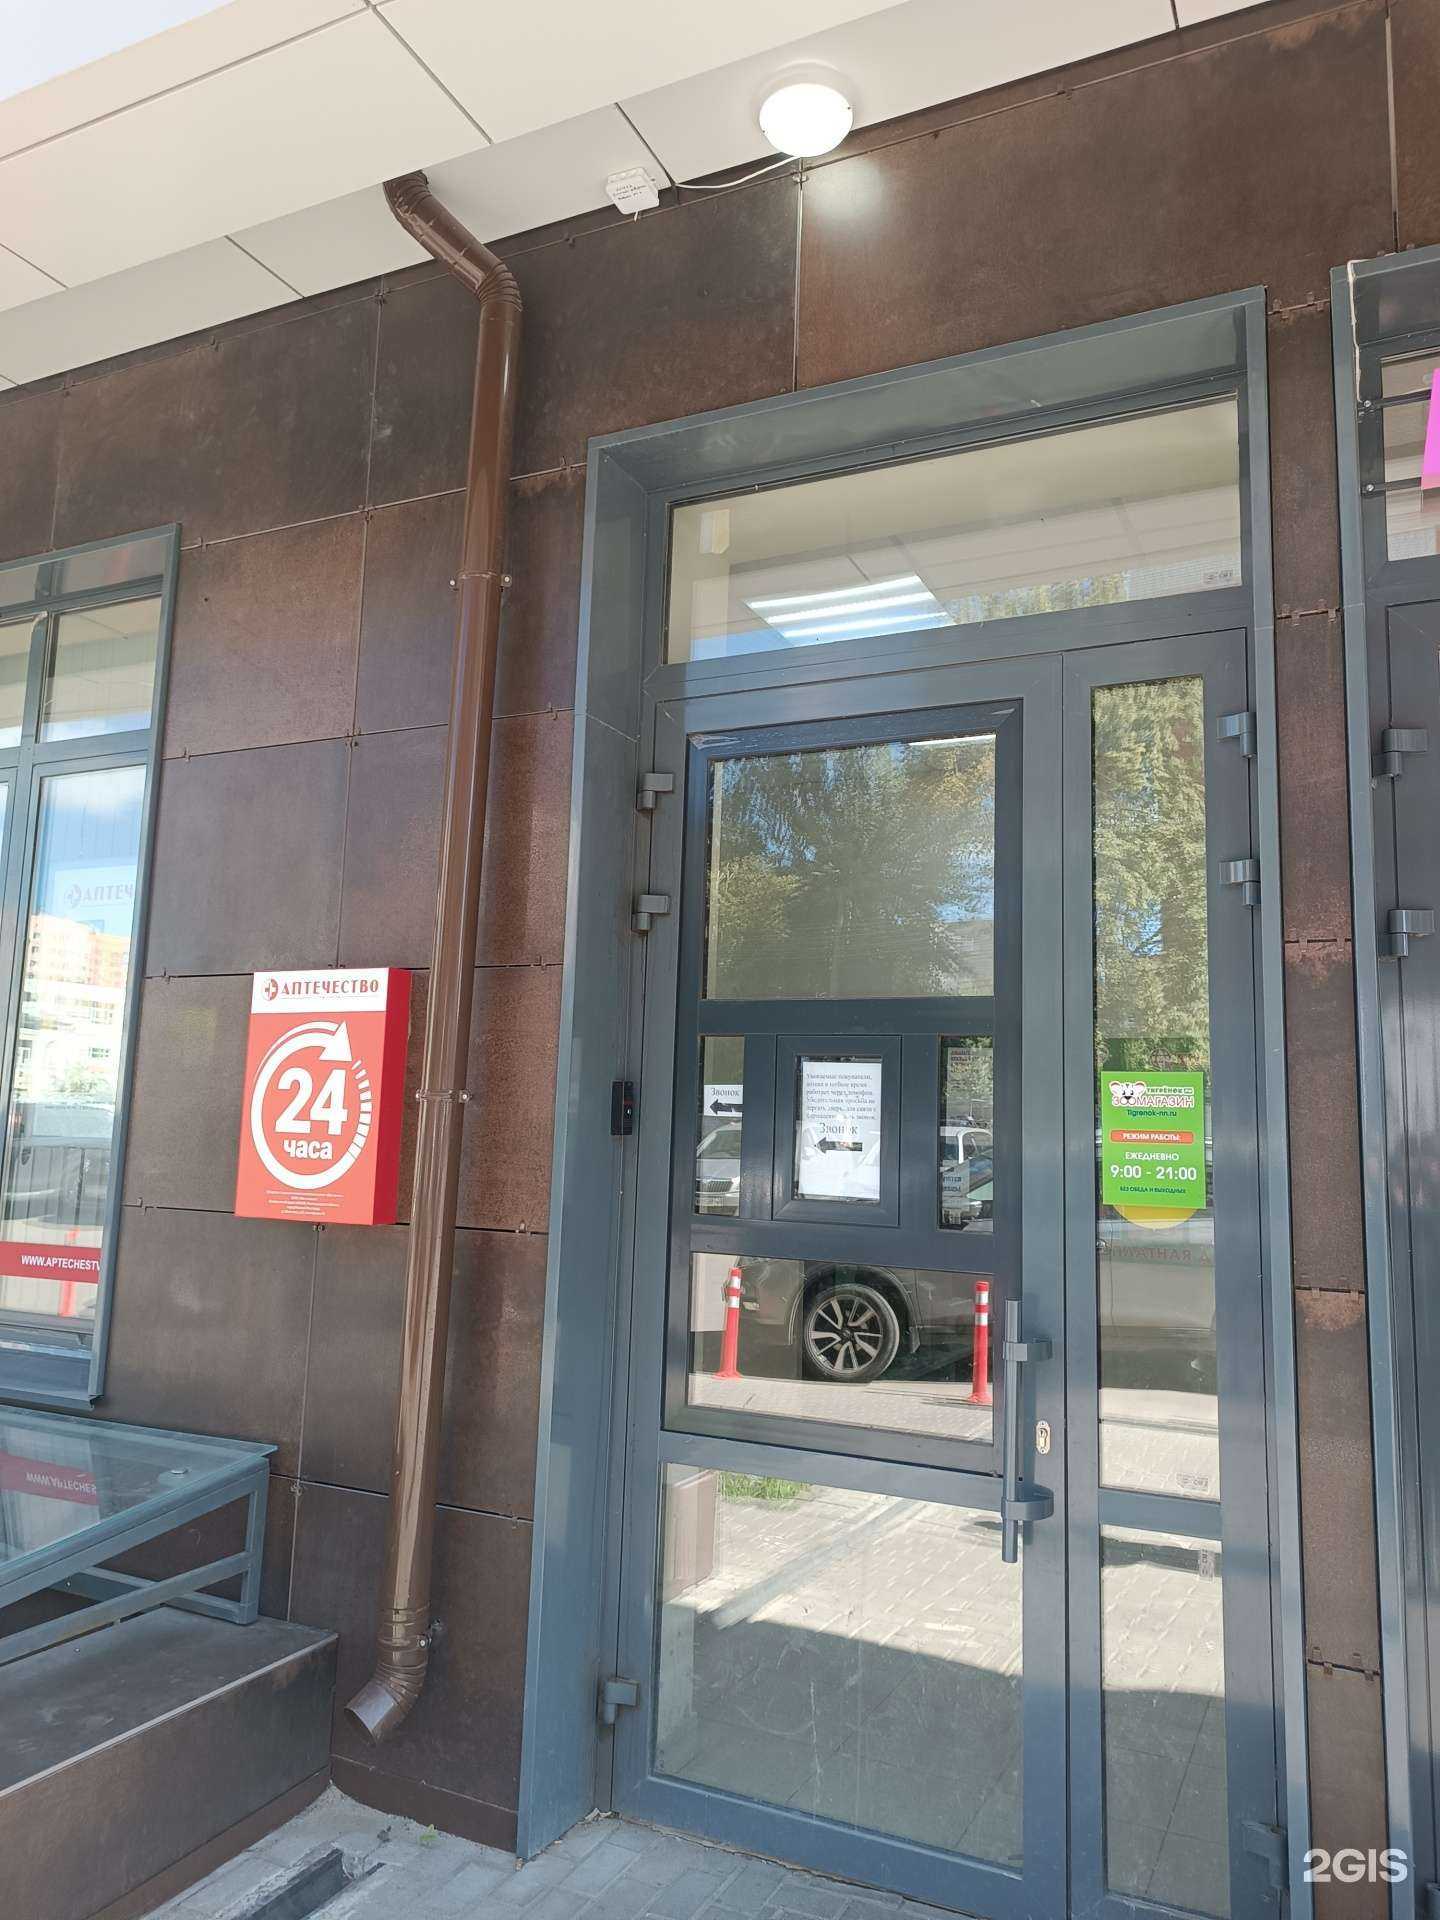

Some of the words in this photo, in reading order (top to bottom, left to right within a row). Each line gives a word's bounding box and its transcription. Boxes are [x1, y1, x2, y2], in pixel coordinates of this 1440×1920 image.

[281, 978, 380, 996] АПТЕЧЕСТВО
[711, 1087, 740, 1097] Звонок
[275, 1067, 348, 1135] 24
[1122, 1132, 1150, 1140] РЕЖИМ
[283, 1139, 333, 1160] часа
[1125, 1151, 1180, 1161] ЕЖЕДНЕВНО
[1110, 1164, 1142, 1178] 9:00
[1155, 1166, 1197, 1180] 21:00
